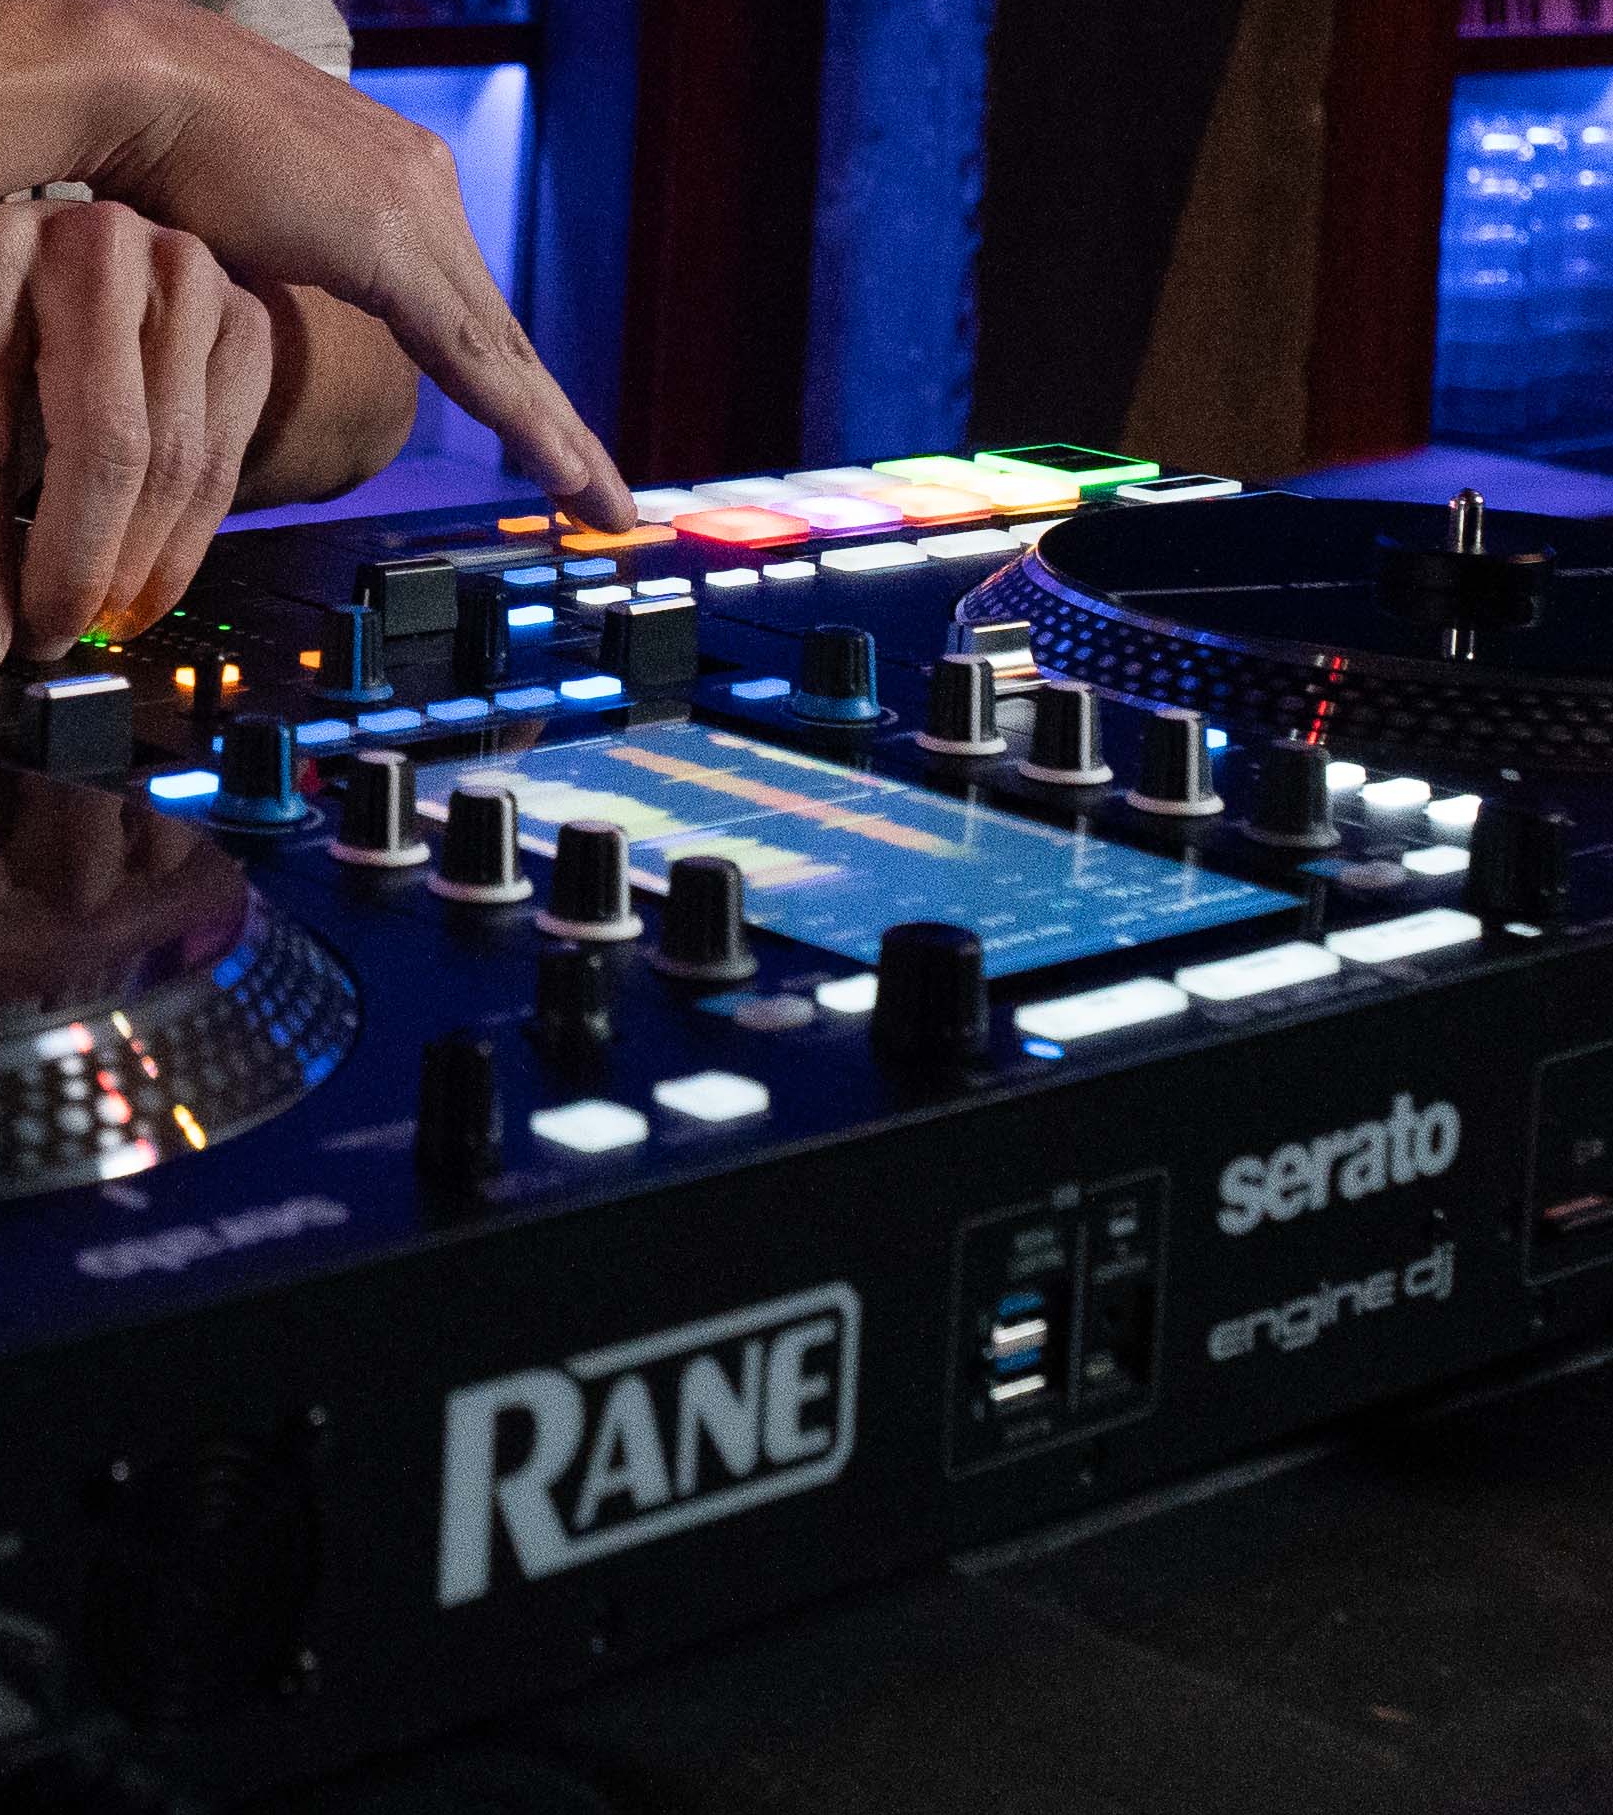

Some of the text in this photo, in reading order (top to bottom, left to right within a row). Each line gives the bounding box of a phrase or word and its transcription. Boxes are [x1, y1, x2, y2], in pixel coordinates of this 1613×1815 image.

[1218, 1093, 1461, 1235] serato
[1207, 1241, 1456, 1363] engine dj
[437, 1312, 848, 1609] RANE
